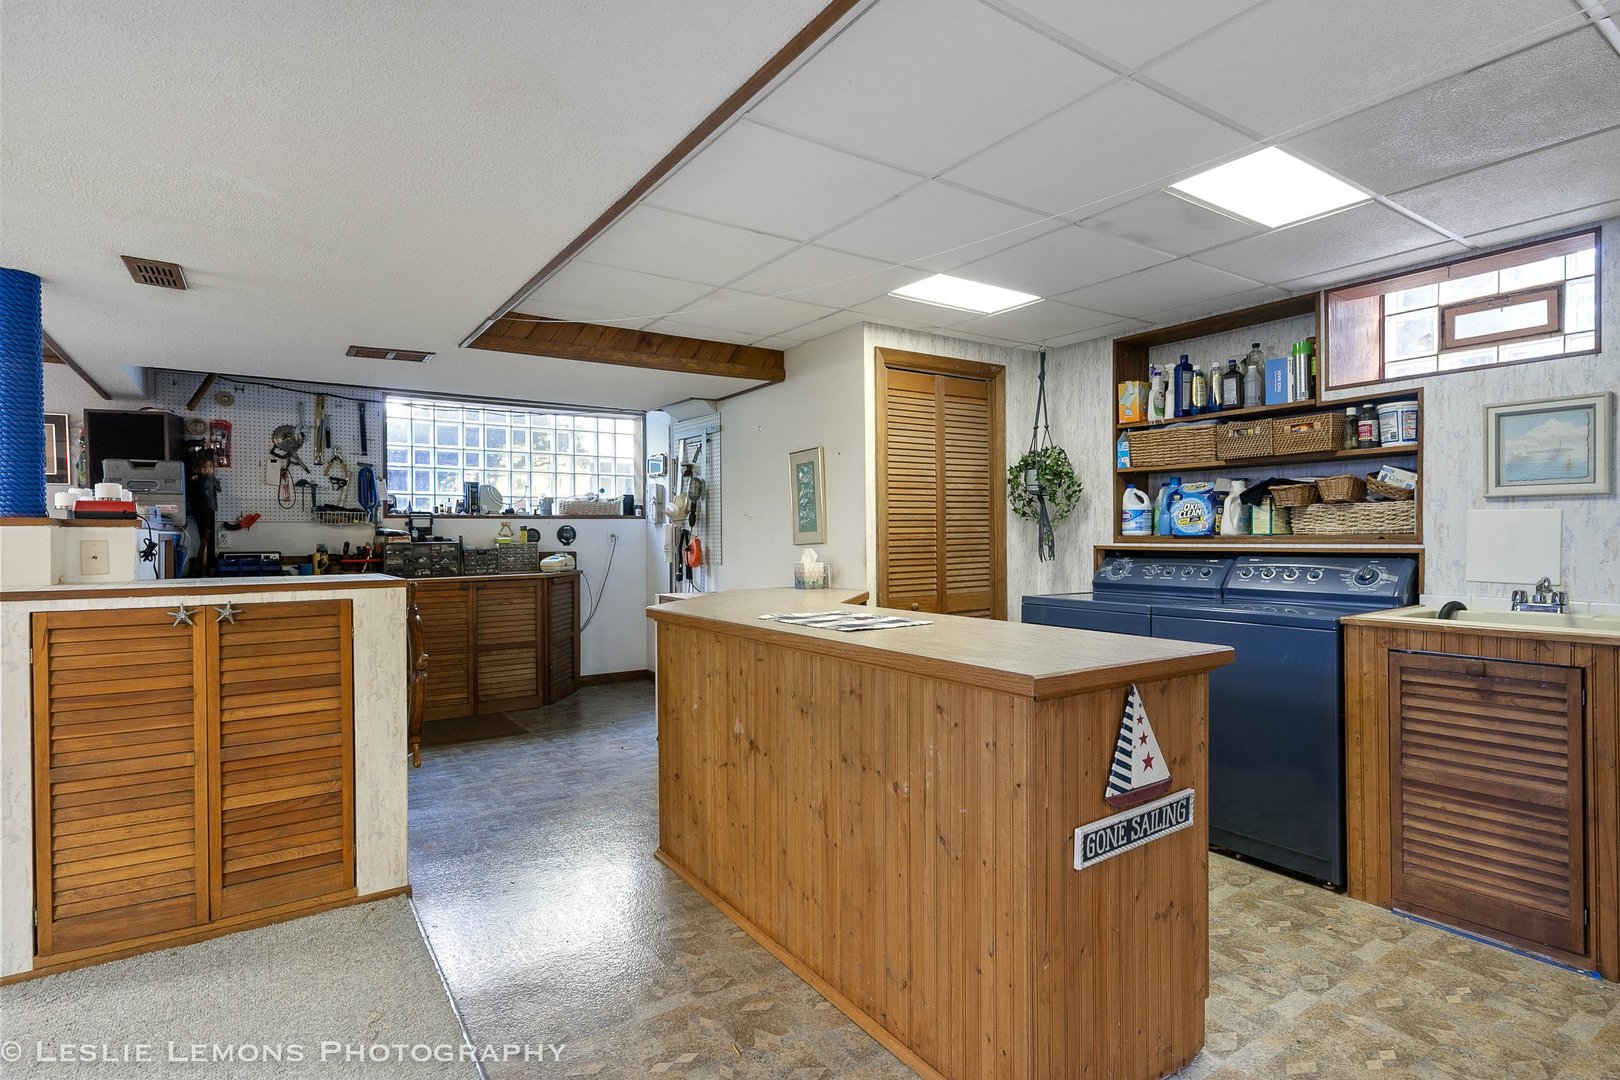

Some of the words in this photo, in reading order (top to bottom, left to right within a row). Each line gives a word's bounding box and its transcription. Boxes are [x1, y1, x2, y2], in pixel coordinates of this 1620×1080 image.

[1184, 503, 1198, 511] OXI
[1178, 508, 1202, 519] CLEAN
[1086, 822, 1127, 858] GONE
[1130, 798, 1187, 841] SAILING
